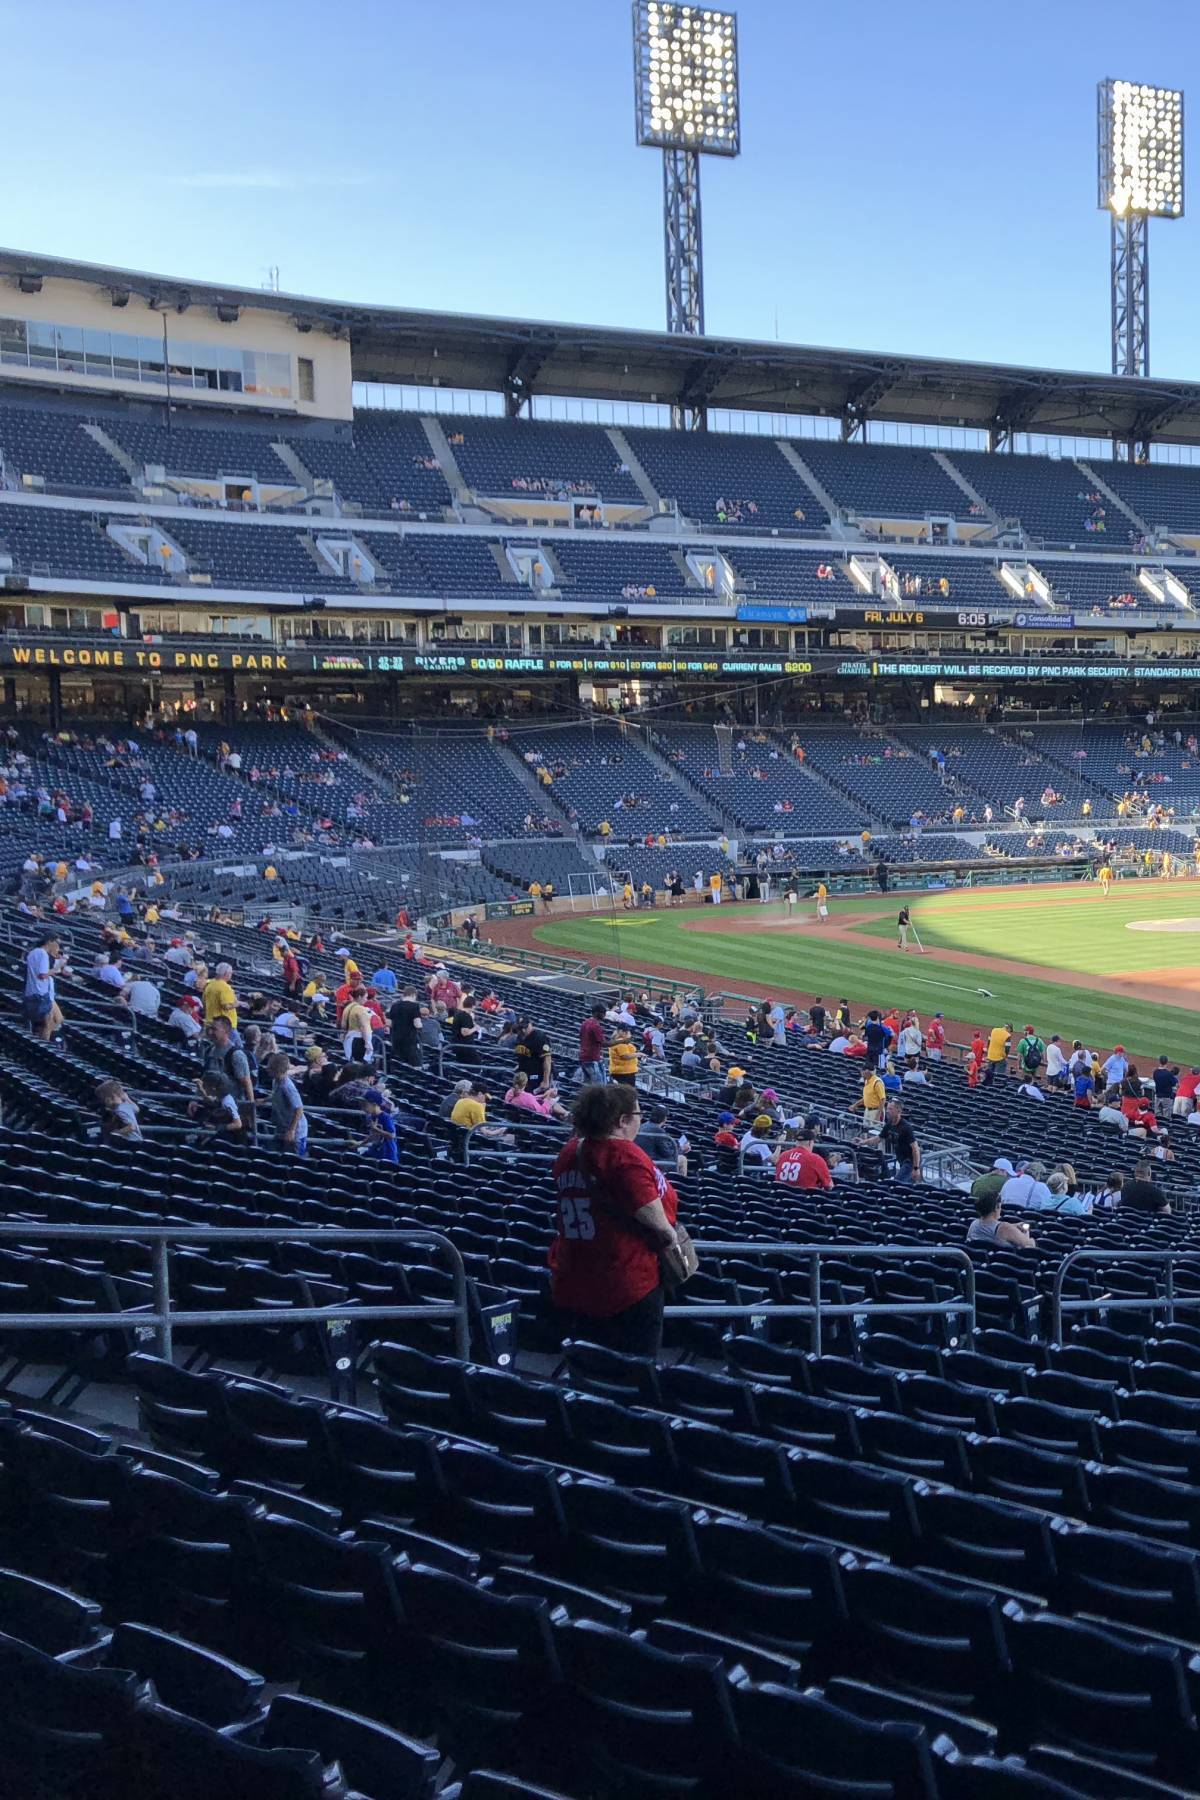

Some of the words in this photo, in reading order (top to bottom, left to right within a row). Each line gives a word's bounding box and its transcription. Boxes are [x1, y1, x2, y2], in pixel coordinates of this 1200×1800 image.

[864, 611, 884, 624] FRI,
[886, 612, 914, 622] JULY
[915, 612, 924, 623] 6
[958, 613, 986, 626] 6:05
[1028, 614, 1072, 622] Consolidated
[12, 648, 124, 666] WELCOME
[136, 652, 162, 667] TO
[175, 653, 219, 668] PNC
[232, 654, 288, 669] PARK
[415, 656, 466, 666] RIVERS
[504, 659, 544, 670] RAFFLE
[556, 660, 572, 669] FOR
[594, 661, 609, 670] FOR
[642, 662, 656, 670] FOR
[688, 662, 702, 670] FOR
[722, 662, 758, 672] CURRENT
[758, 664, 782, 672] SALES
[784, 662, 812, 673] $200
[878, 664, 898, 674] THE
[899, 664, 942, 674] REQUEST
[944, 664, 966, 674] WILL
[968, 665, 980, 674] BE
[982, 666, 1026, 675] RECEIVED
[1027, 666, 1040, 676] BY
[1042, 666, 1060, 676] PNC
[1062, 667, 1086, 676] PARK
[1088, 667, 1130, 676] SECURITY.
[1134, 668, 1180, 677] STANDARD
[790, 1152, 802, 1160] LEE
[780, 1161, 802, 1182] 33
[560, 1197, 596, 1240] 25
